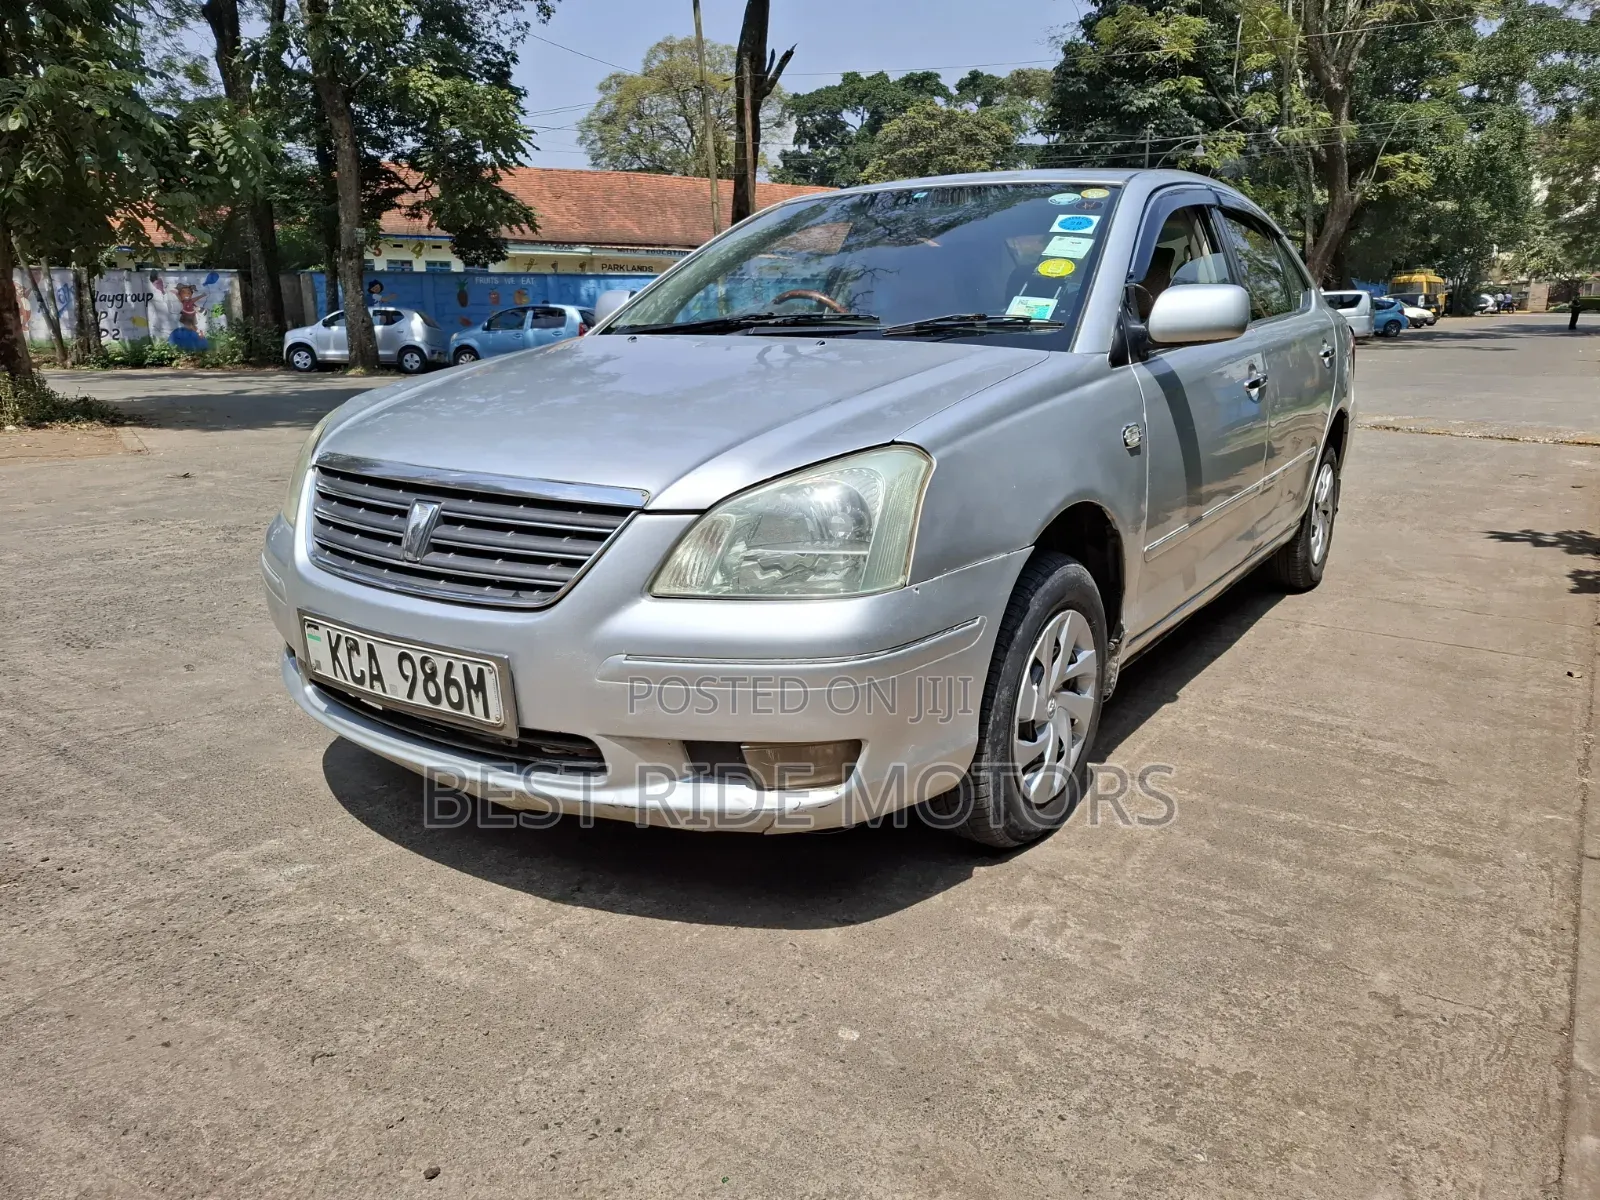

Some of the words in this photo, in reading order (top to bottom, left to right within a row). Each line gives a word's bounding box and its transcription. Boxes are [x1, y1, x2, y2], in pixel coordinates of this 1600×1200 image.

[601, 263, 654, 273] PARKLANDS
[475, 276, 499, 285] FRUITS
[504, 277, 516, 285] WE
[521, 277, 535, 285] EAT
[94, 290, 154, 309] laygroup
[326, 630, 387, 694] KCA
[397, 650, 491, 720] 986M
